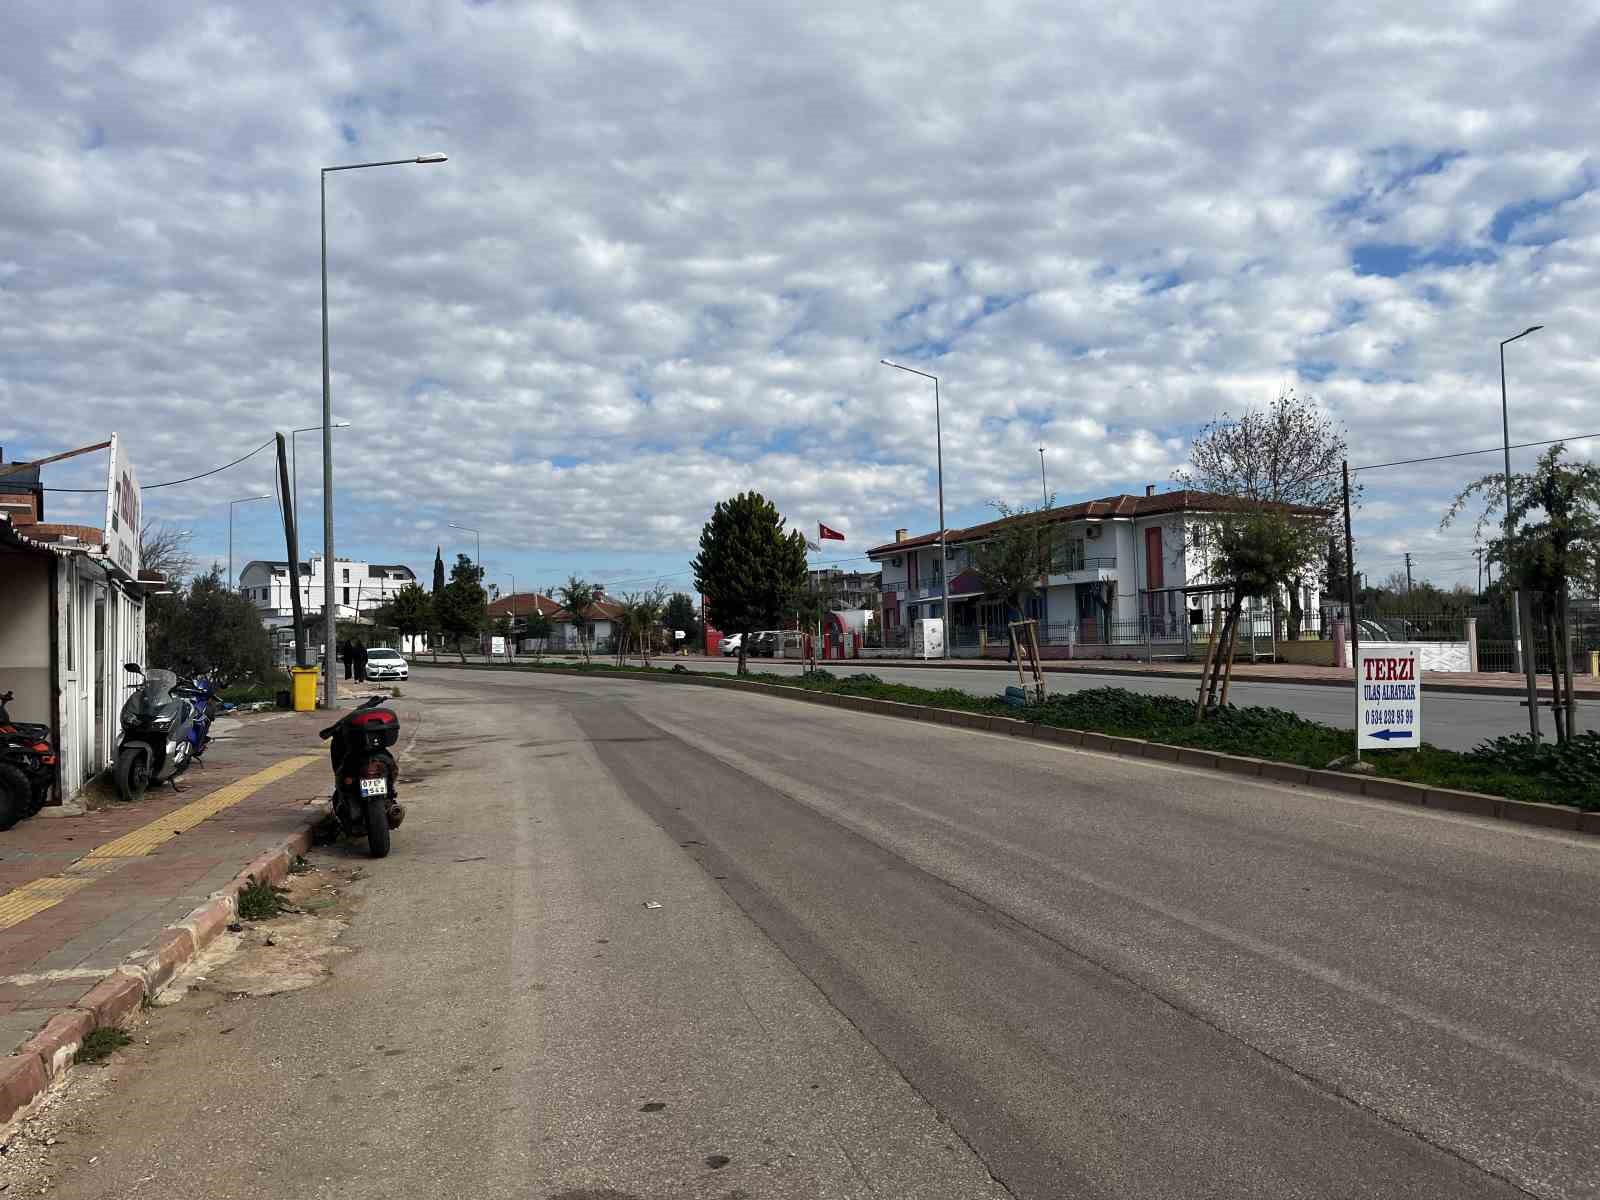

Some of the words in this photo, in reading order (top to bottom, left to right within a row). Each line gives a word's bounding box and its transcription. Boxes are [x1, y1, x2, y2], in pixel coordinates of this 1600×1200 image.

[1364, 651, 1415, 681] TERZİ
[1364, 685, 1381, 705] ULAŞ
[1382, 685, 1416, 700] ALBAYRAK
[1365, 709, 1370, 725] 0
[1371, 709, 1383, 725] 534
[1384, 709, 1395, 725] 232
